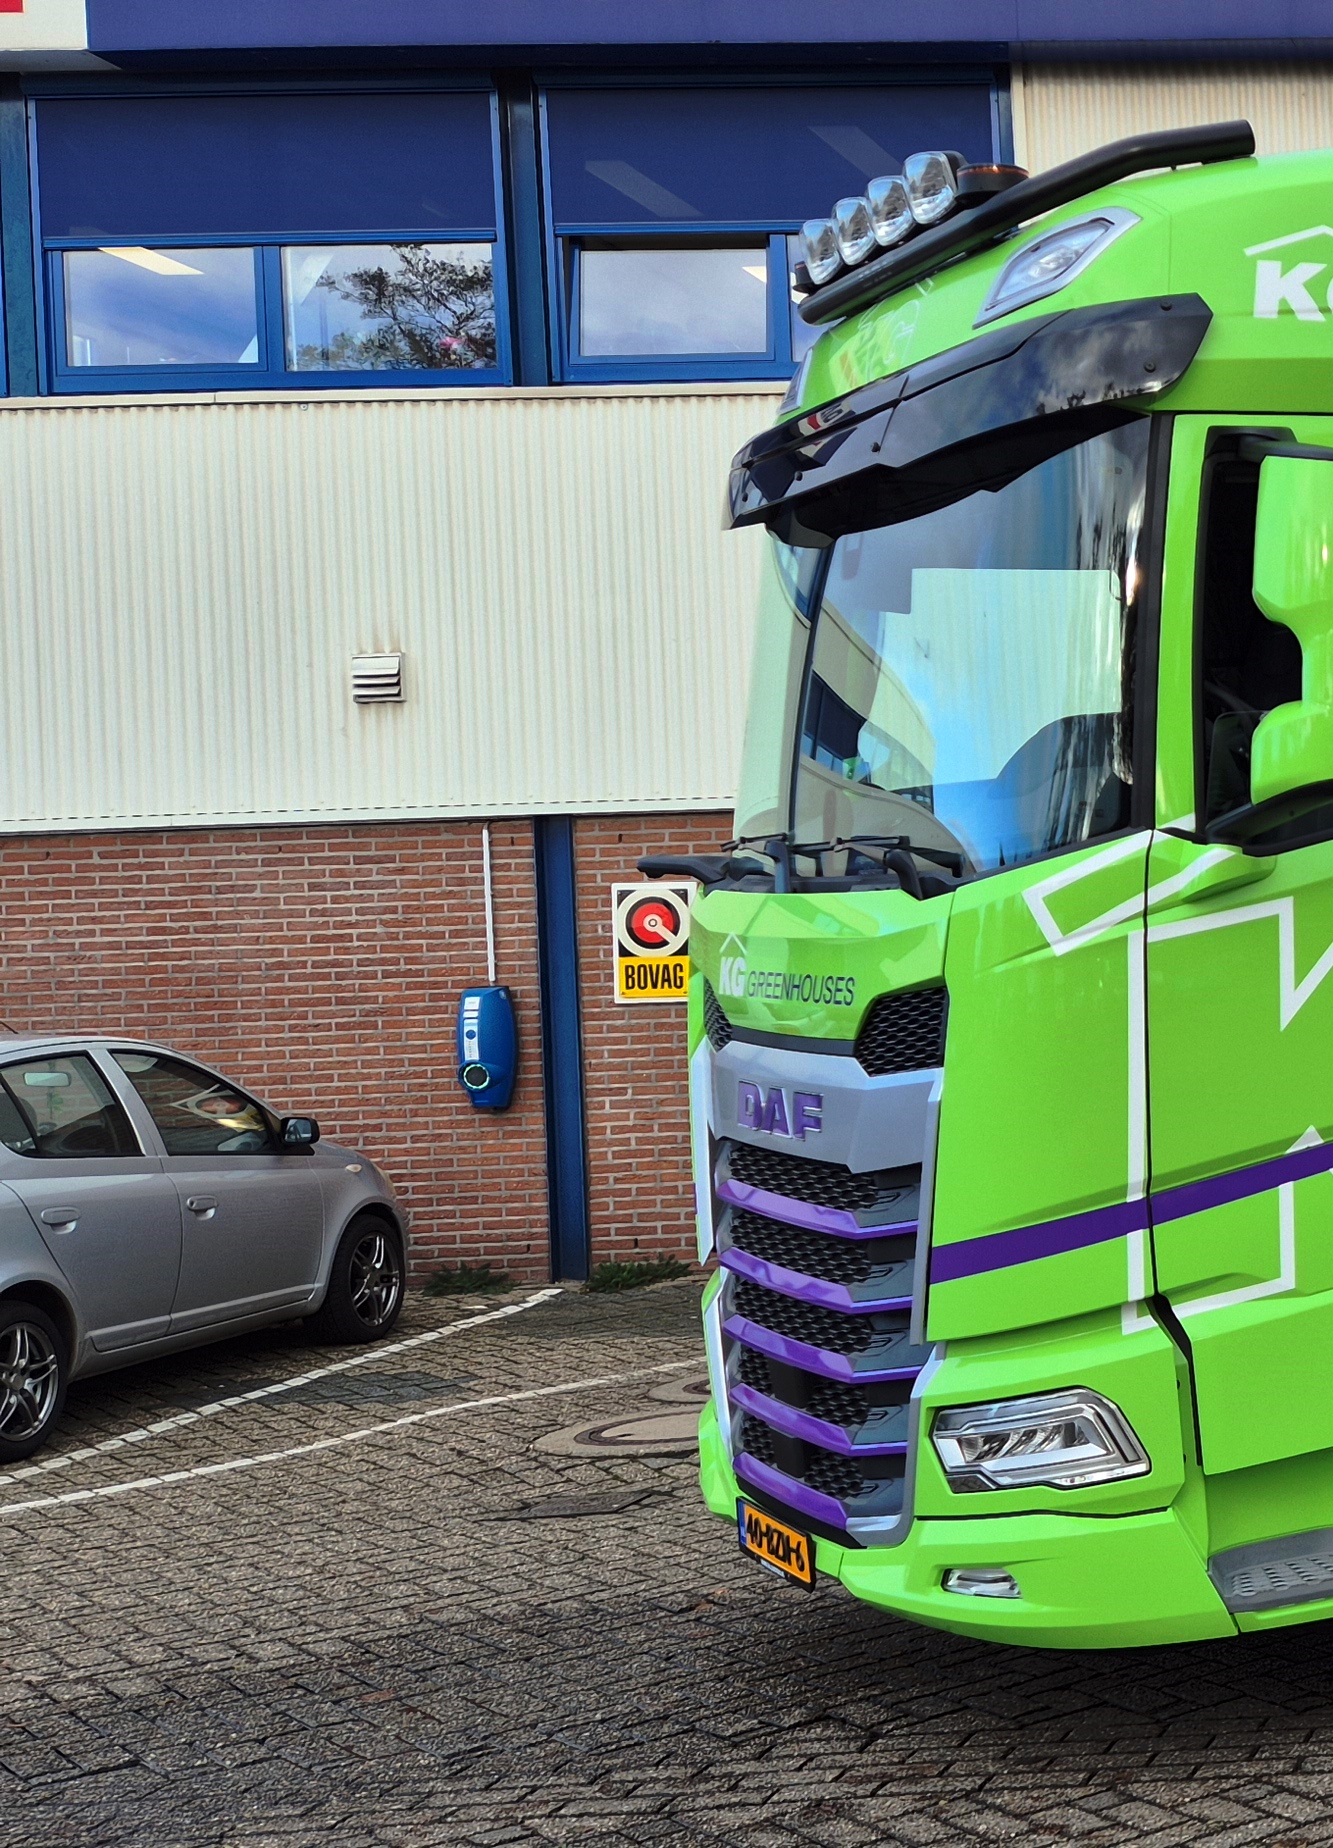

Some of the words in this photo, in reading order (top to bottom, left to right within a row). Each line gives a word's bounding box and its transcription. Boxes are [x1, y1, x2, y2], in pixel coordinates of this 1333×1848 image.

[624, 963, 684, 990] BOVAG
[719, 956, 747, 997] KG
[747, 970, 856, 1006] GREENHOUSES
[737, 1079, 824, 1142] DAF
